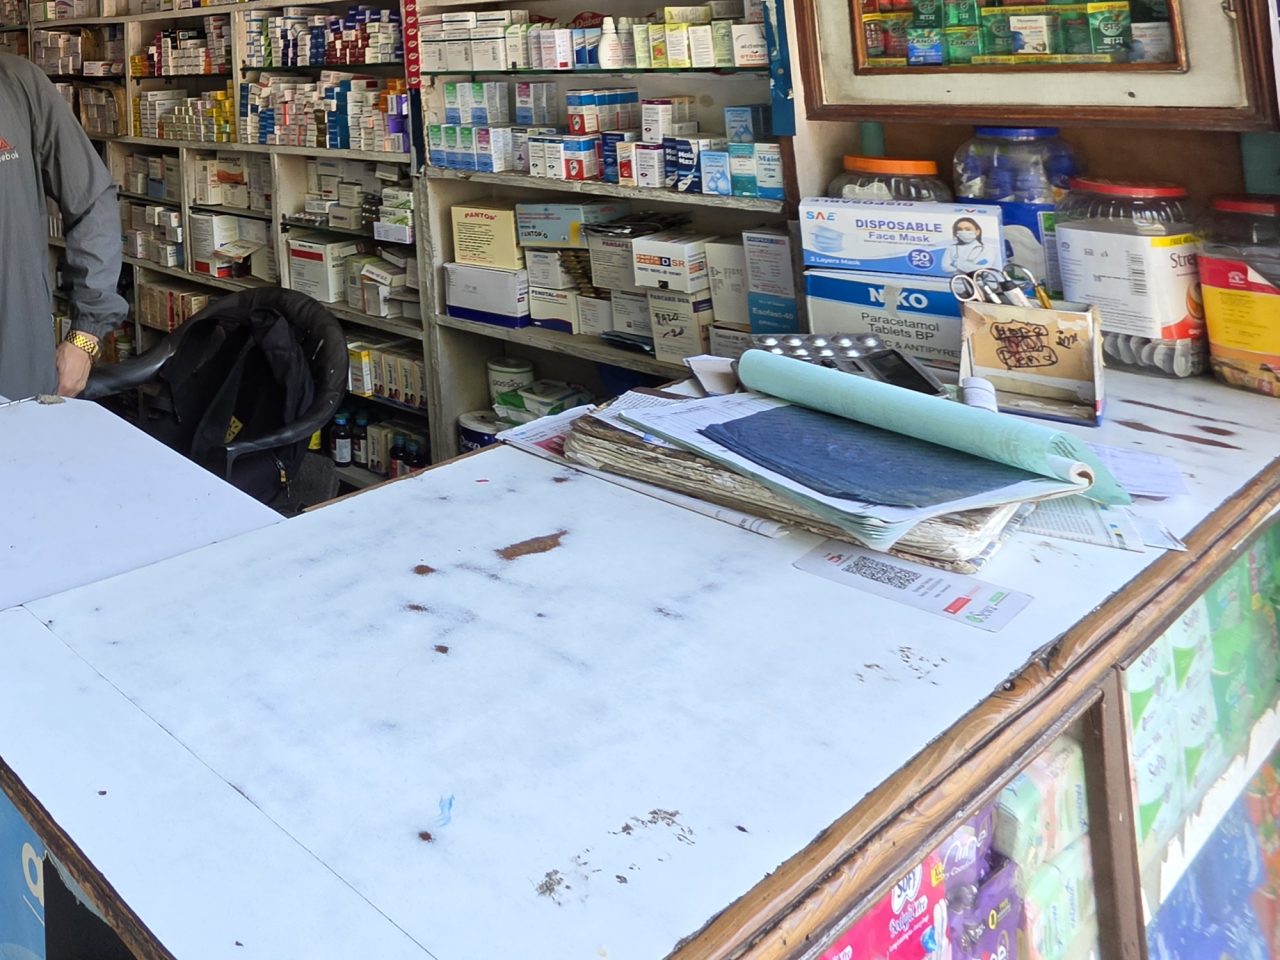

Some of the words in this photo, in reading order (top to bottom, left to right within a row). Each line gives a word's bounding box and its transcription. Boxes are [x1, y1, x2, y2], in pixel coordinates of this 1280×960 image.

[575, 15, 604, 29] Dabur
[855, 219, 943, 233] DISPOSABLE
[868, 231, 896, 242] Face
[899, 233, 931, 243] Mask
[910, 251, 929, 262] 50
[911, 260, 931, 268] PCS
[1170, 252, 1198, 269] Stre
[868, 287, 929, 309] NKO
[861, 312, 940, 333] Paracetamol
[868, 323, 912, 339] Tablets
[915, 330, 934, 340] BP
[894, 342, 903, 350] &
[904, 343, 961, 359] ANTIPYRE
